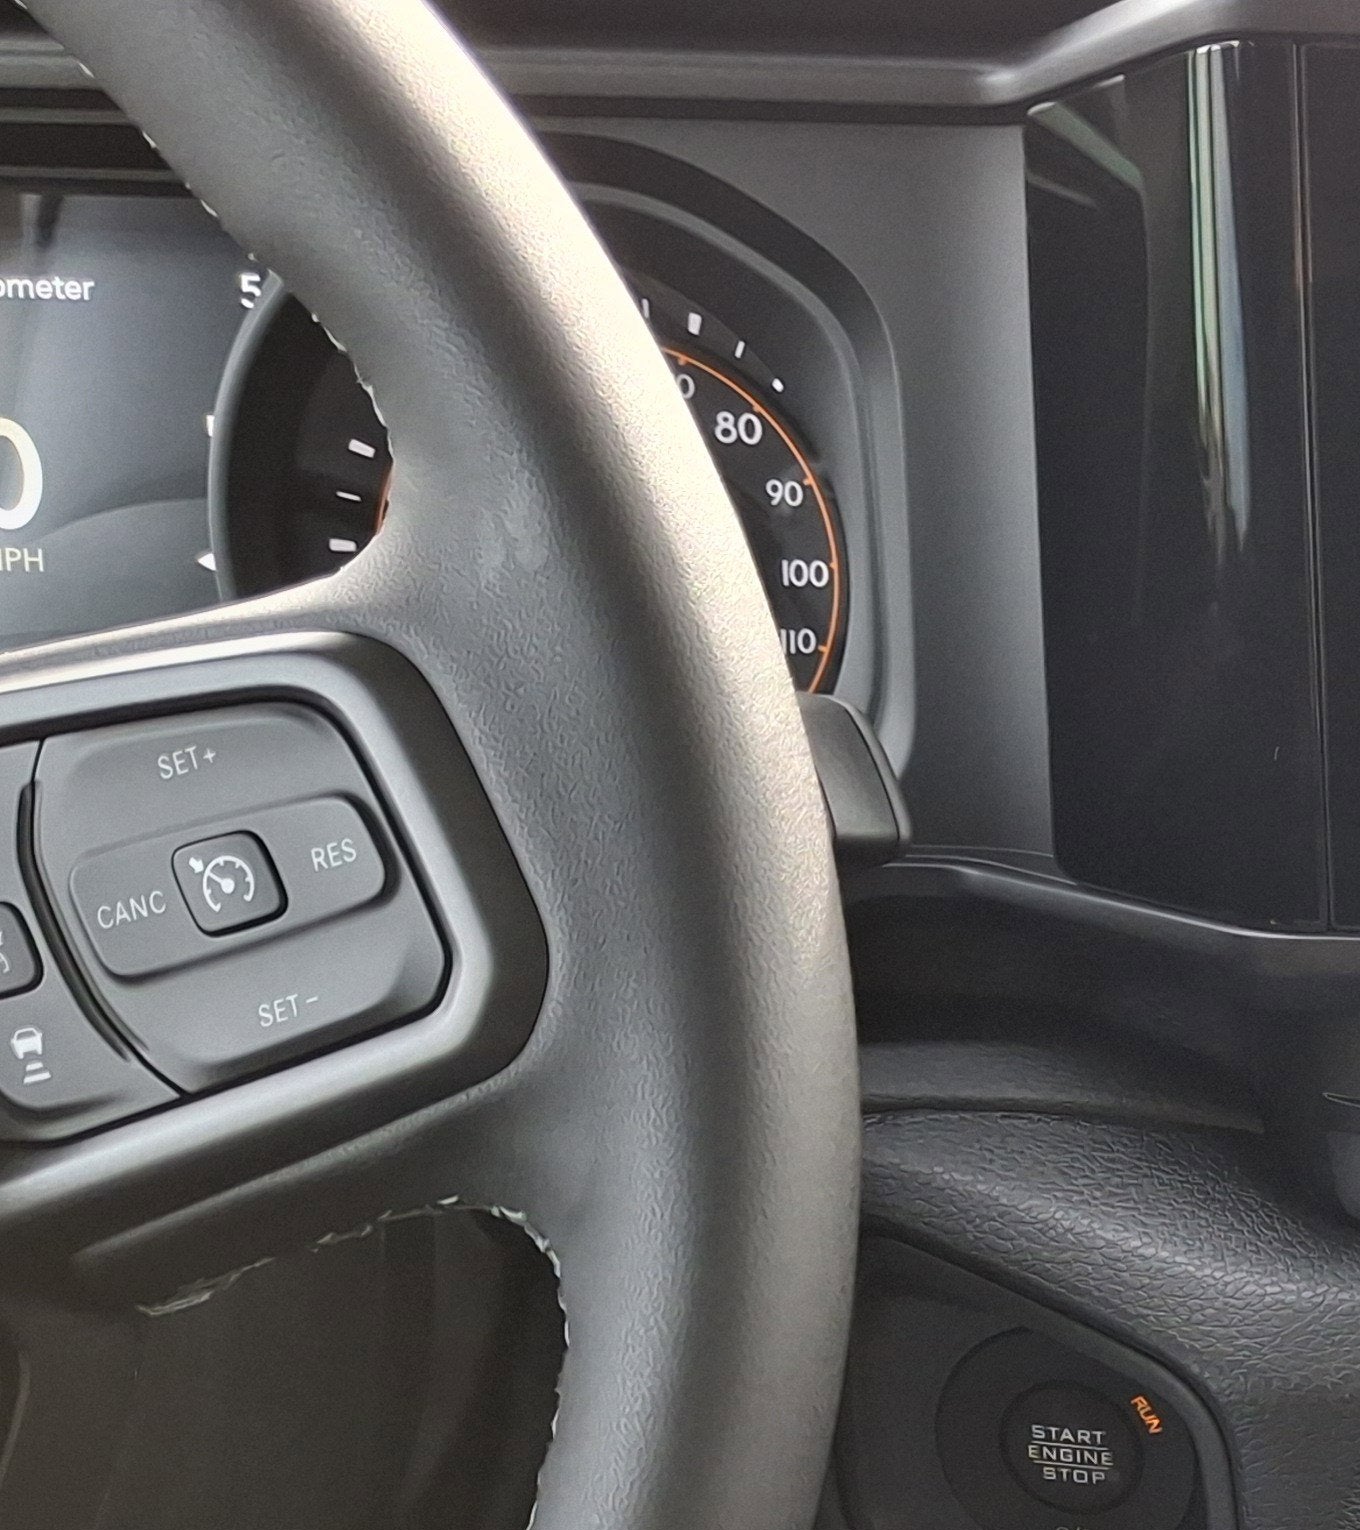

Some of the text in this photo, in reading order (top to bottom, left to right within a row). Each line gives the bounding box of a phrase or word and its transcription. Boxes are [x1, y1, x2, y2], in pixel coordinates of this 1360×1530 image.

[714, 411, 763, 445] 80
[765, 478, 803, 507] 90
[0, 548, 45, 573] PH
[781, 559, 829, 587] 100
[311, 838, 357, 873] RES
[97, 890, 167, 930] CANC
[1130, 1395, 1162, 1435] RUN
[1030, 1424, 1106, 1445] START
[1028, 1445, 1114, 1466] ENGINE
[1042, 1466, 1106, 1485] STOP
